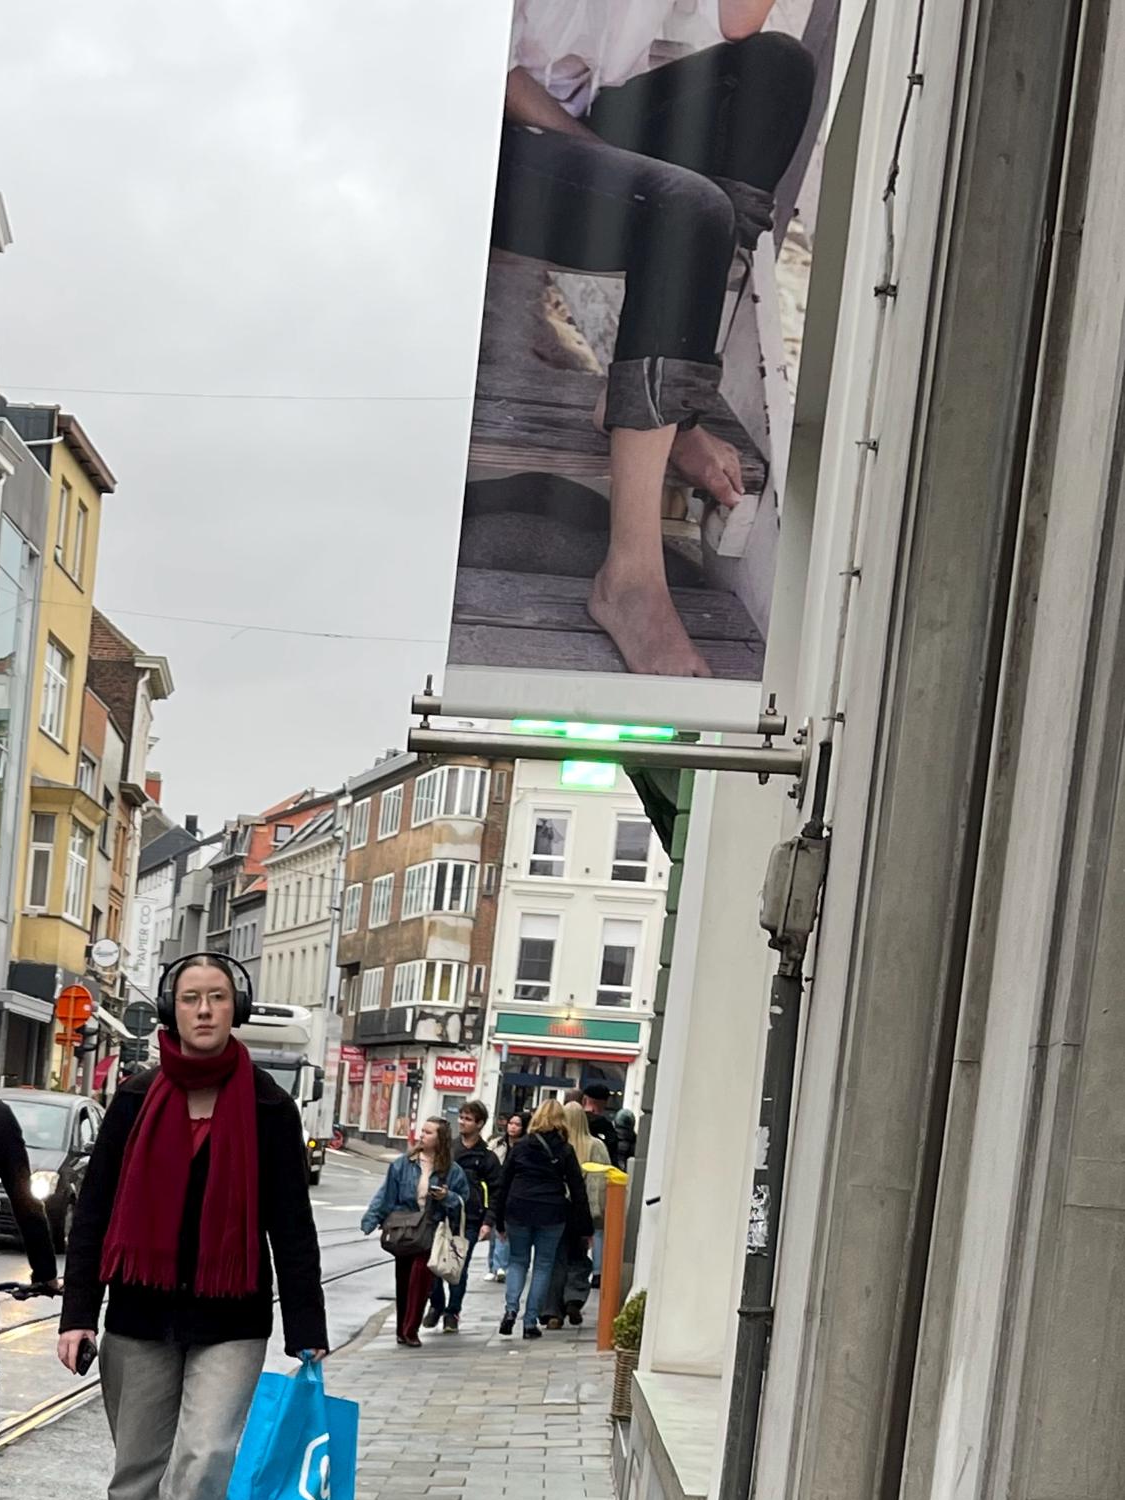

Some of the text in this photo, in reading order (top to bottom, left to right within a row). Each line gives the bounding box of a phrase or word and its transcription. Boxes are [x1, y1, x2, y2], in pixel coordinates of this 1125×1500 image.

[140, 904, 152, 926] CO
[436, 1059, 476, 1073] NACHT
[434, 1075, 476, 1088] WINKEL
